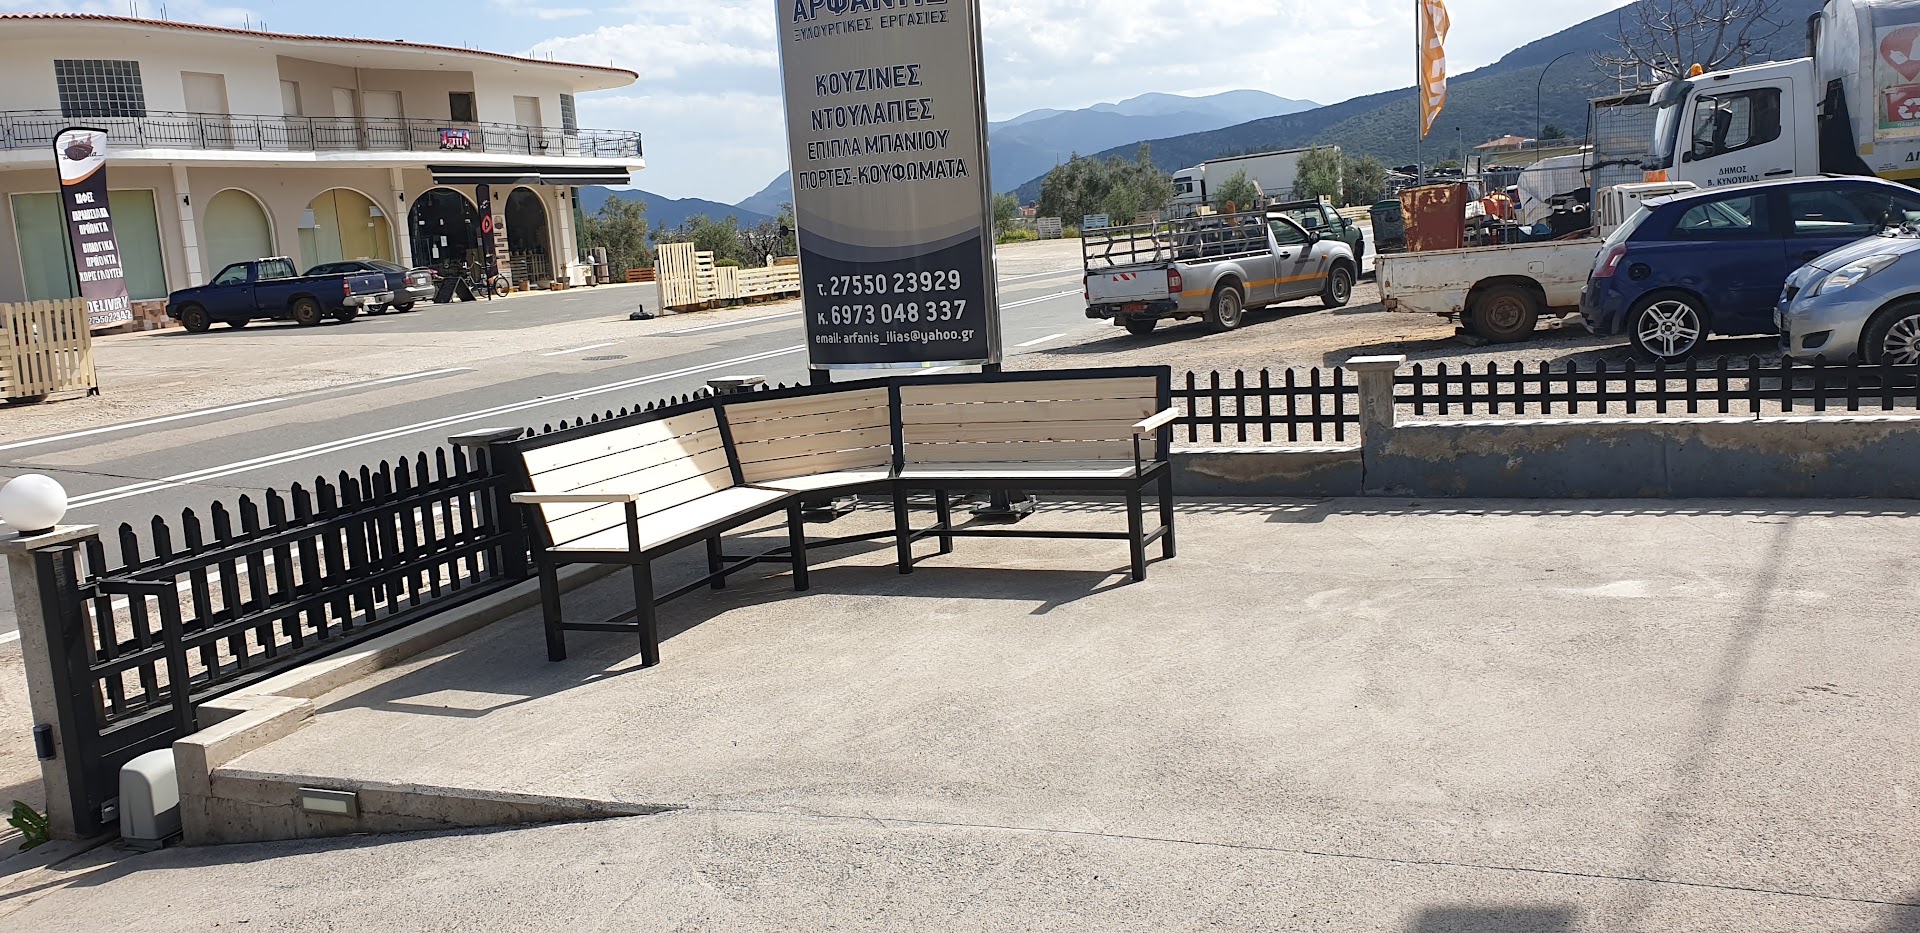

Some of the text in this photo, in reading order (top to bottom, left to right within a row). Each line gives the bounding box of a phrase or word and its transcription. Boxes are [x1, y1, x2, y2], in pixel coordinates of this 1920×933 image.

[794, 10, 949, 41] ΞΥΛΟΥΡΓΙΚΕΣ ΕΡΓΑΣΙΕΣ
[815, 64, 922, 97] ΚΟΥΖΙΝΕΣ
[811, 97, 934, 131] ΝΤΟΥΛΑΠΕΣ
[807, 129, 950, 161] ΕΠΙΠΛΑ ΜΠΑΝΙΟΥ
[799, 158, 969, 190] ΠΟΡΤΕΣ-ΚΟΥΦΩΜΑΤΑ
[1717, 174, 1760, 186] ΚΥΝΟΥΡΙΑΣ
[1719, 165, 1747, 175] ΔΗΜΟΣ
[829, 273, 887, 296] 27550
[893, 269, 961, 294] 23929
[831, 304, 875, 325] 6973
[881, 302, 919, 323] 048
[925, 299, 967, 322] 337
[815, 328, 975, 346] email: arfanis_ilias@yahoo.gr
